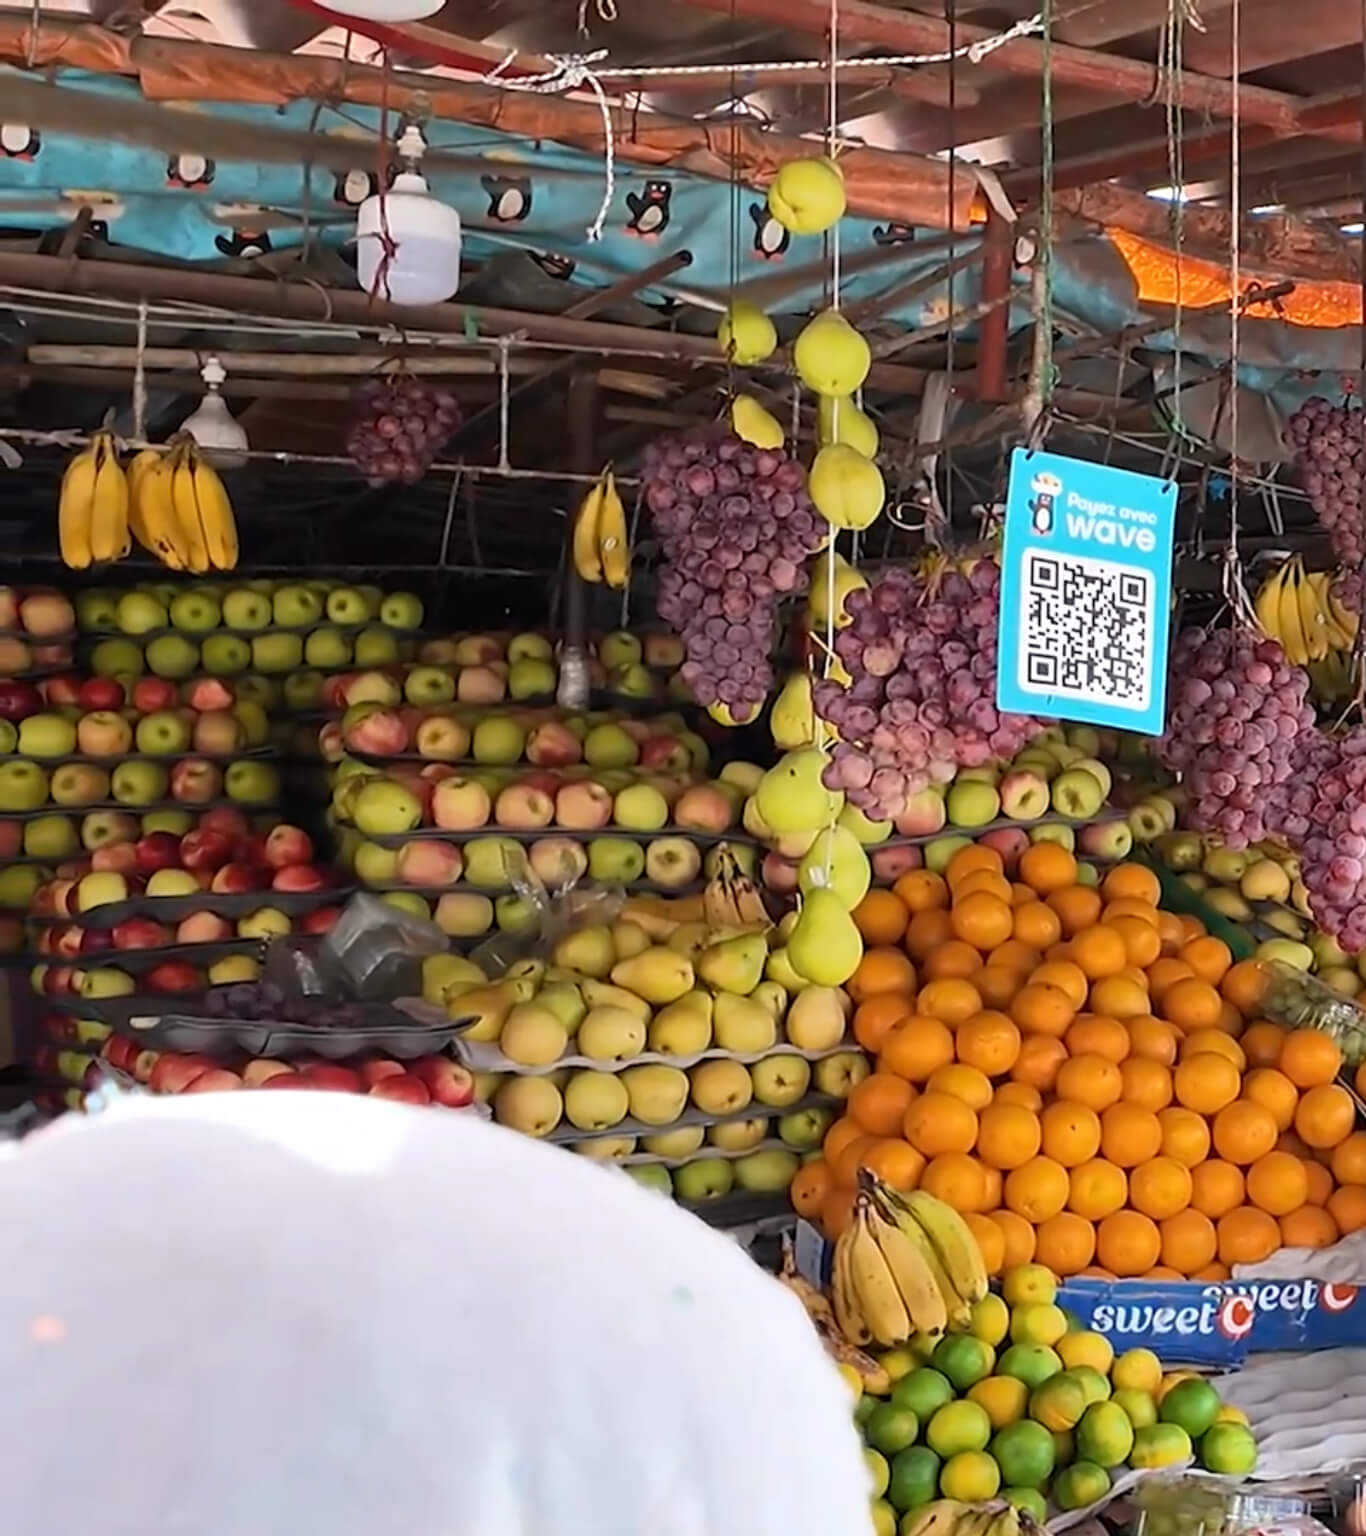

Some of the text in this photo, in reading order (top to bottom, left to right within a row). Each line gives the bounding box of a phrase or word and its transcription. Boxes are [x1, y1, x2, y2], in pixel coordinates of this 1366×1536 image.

[1067, 491, 1157, 525] Payez avec
[1066, 512, 1156, 552] wave
[1091, 1302, 1217, 1335] sweet
